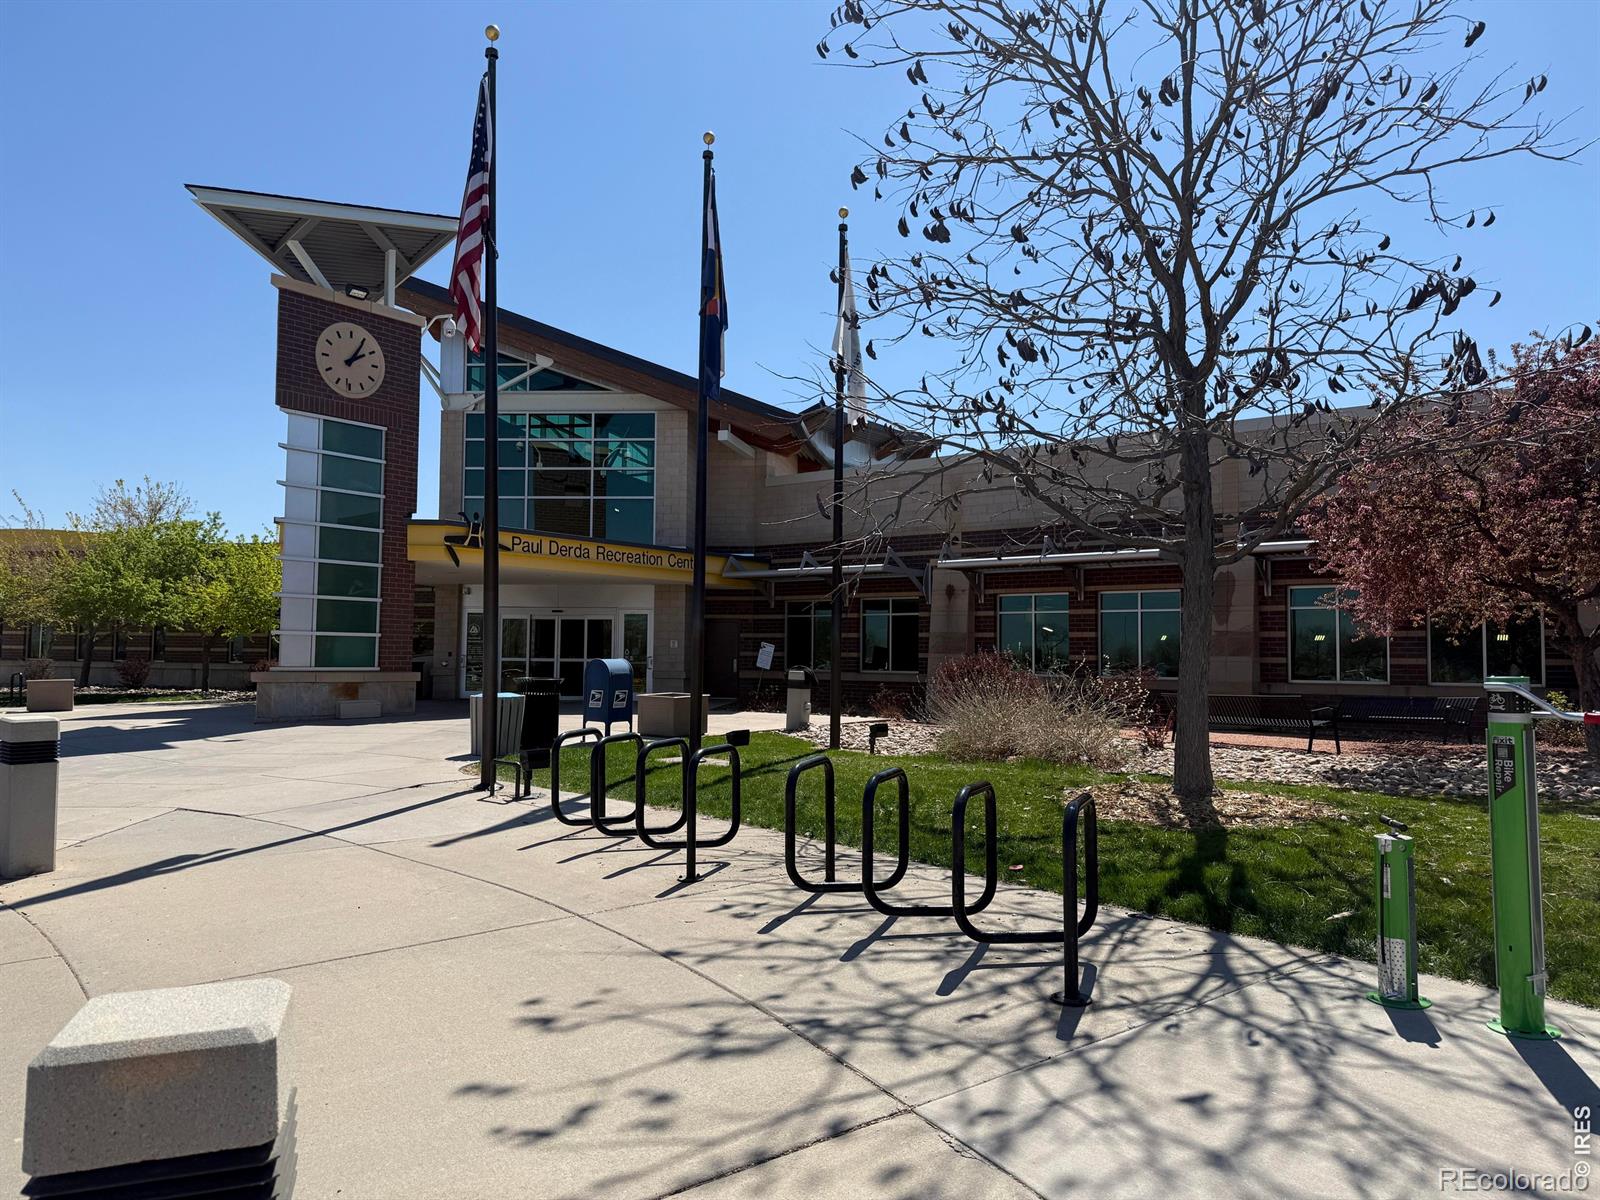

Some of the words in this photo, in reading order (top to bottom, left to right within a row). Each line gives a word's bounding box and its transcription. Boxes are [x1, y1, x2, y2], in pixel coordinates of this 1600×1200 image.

[511, 536, 542, 554] Paul
[549, 540, 590, 559] Derda
[596, 545, 663, 566] Recreation
[667, 553, 695, 570] Cent
[1494, 759, 1504, 792] Repair
[1504, 760, 1514, 782] Bike
